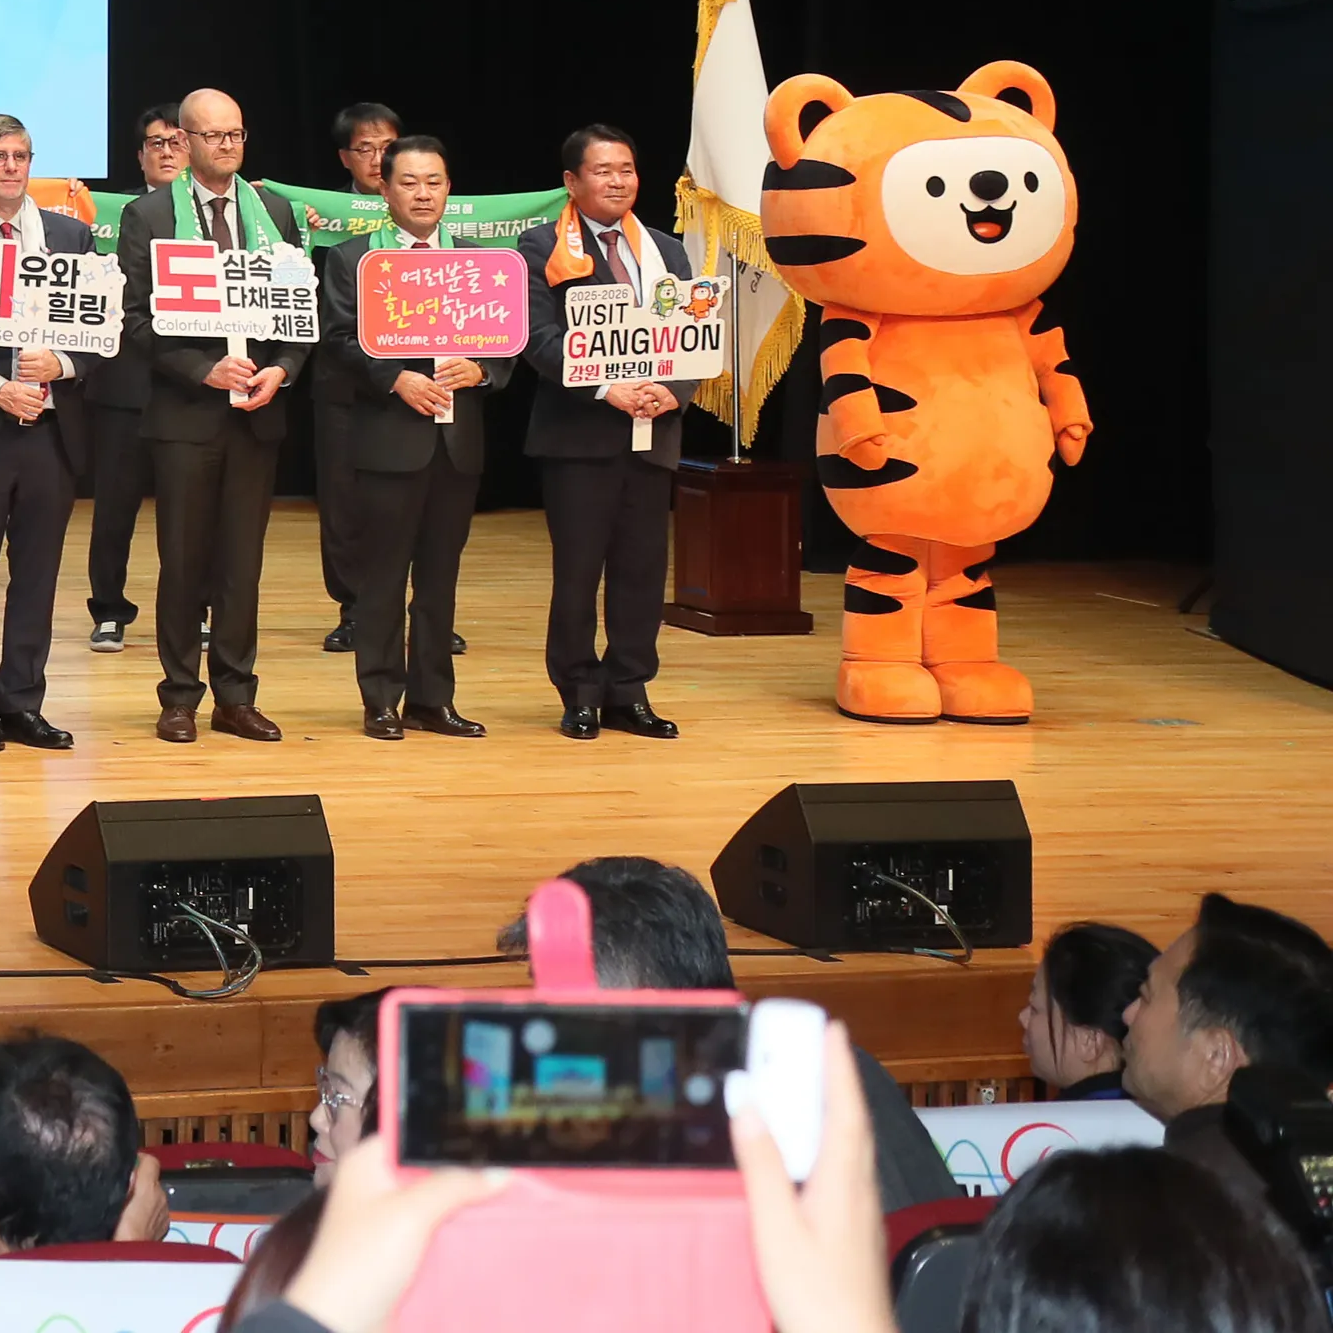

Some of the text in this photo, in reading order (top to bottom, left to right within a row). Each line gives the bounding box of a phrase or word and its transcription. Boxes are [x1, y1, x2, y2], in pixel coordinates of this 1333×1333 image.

[400, 260, 483, 294] 여러분을
[48, 291, 108, 326] 힐링
[226, 286, 313, 311] 다채로운
[570, 289, 629, 303] 2025-2026
[383, 291, 512, 330] 환영합니다
[571, 302, 629, 327] VISIT
[156, 318, 268, 336] Colorful Activity
[272, 314, 315, 338] 체험
[18, 327, 38, 343] of
[41, 329, 116, 353] Healing
[376, 333, 509, 349] Welcome to Gangwon
[568, 323, 721, 359] GANGWON
[568, 360, 674, 383] 강원 방문의 해
